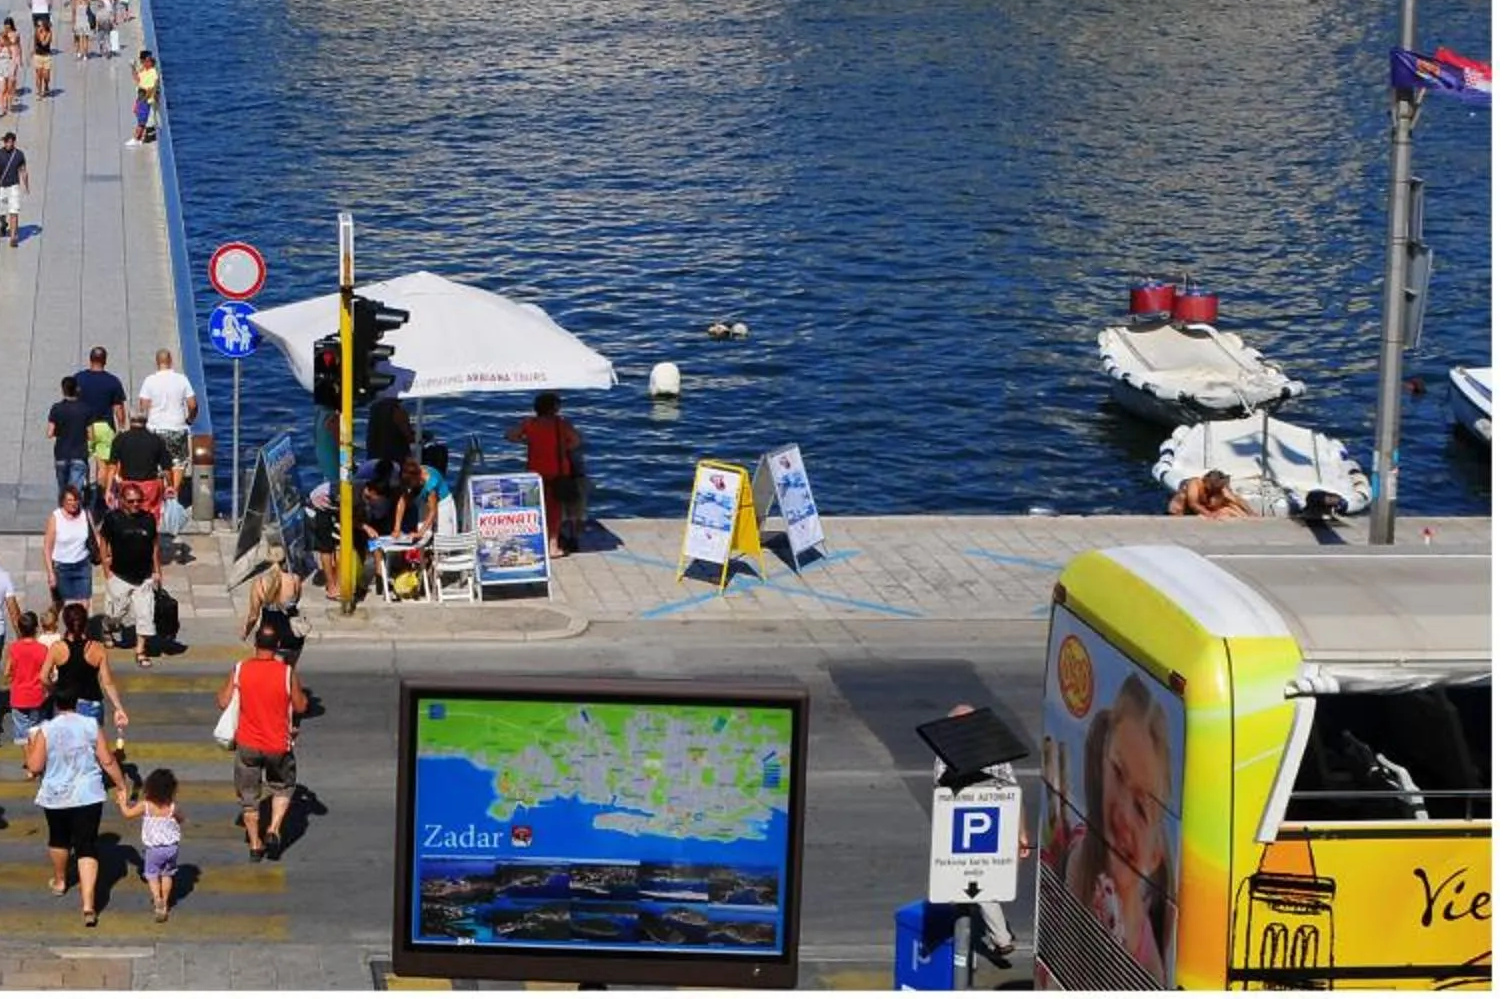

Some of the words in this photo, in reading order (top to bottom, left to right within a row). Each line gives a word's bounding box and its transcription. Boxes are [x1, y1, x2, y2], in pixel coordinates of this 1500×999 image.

[479, 512, 538, 527] KORNATI
[423, 824, 504, 848] Zadar
[962, 812, 992, 849] P
[1413, 867, 1491, 927] Vie
